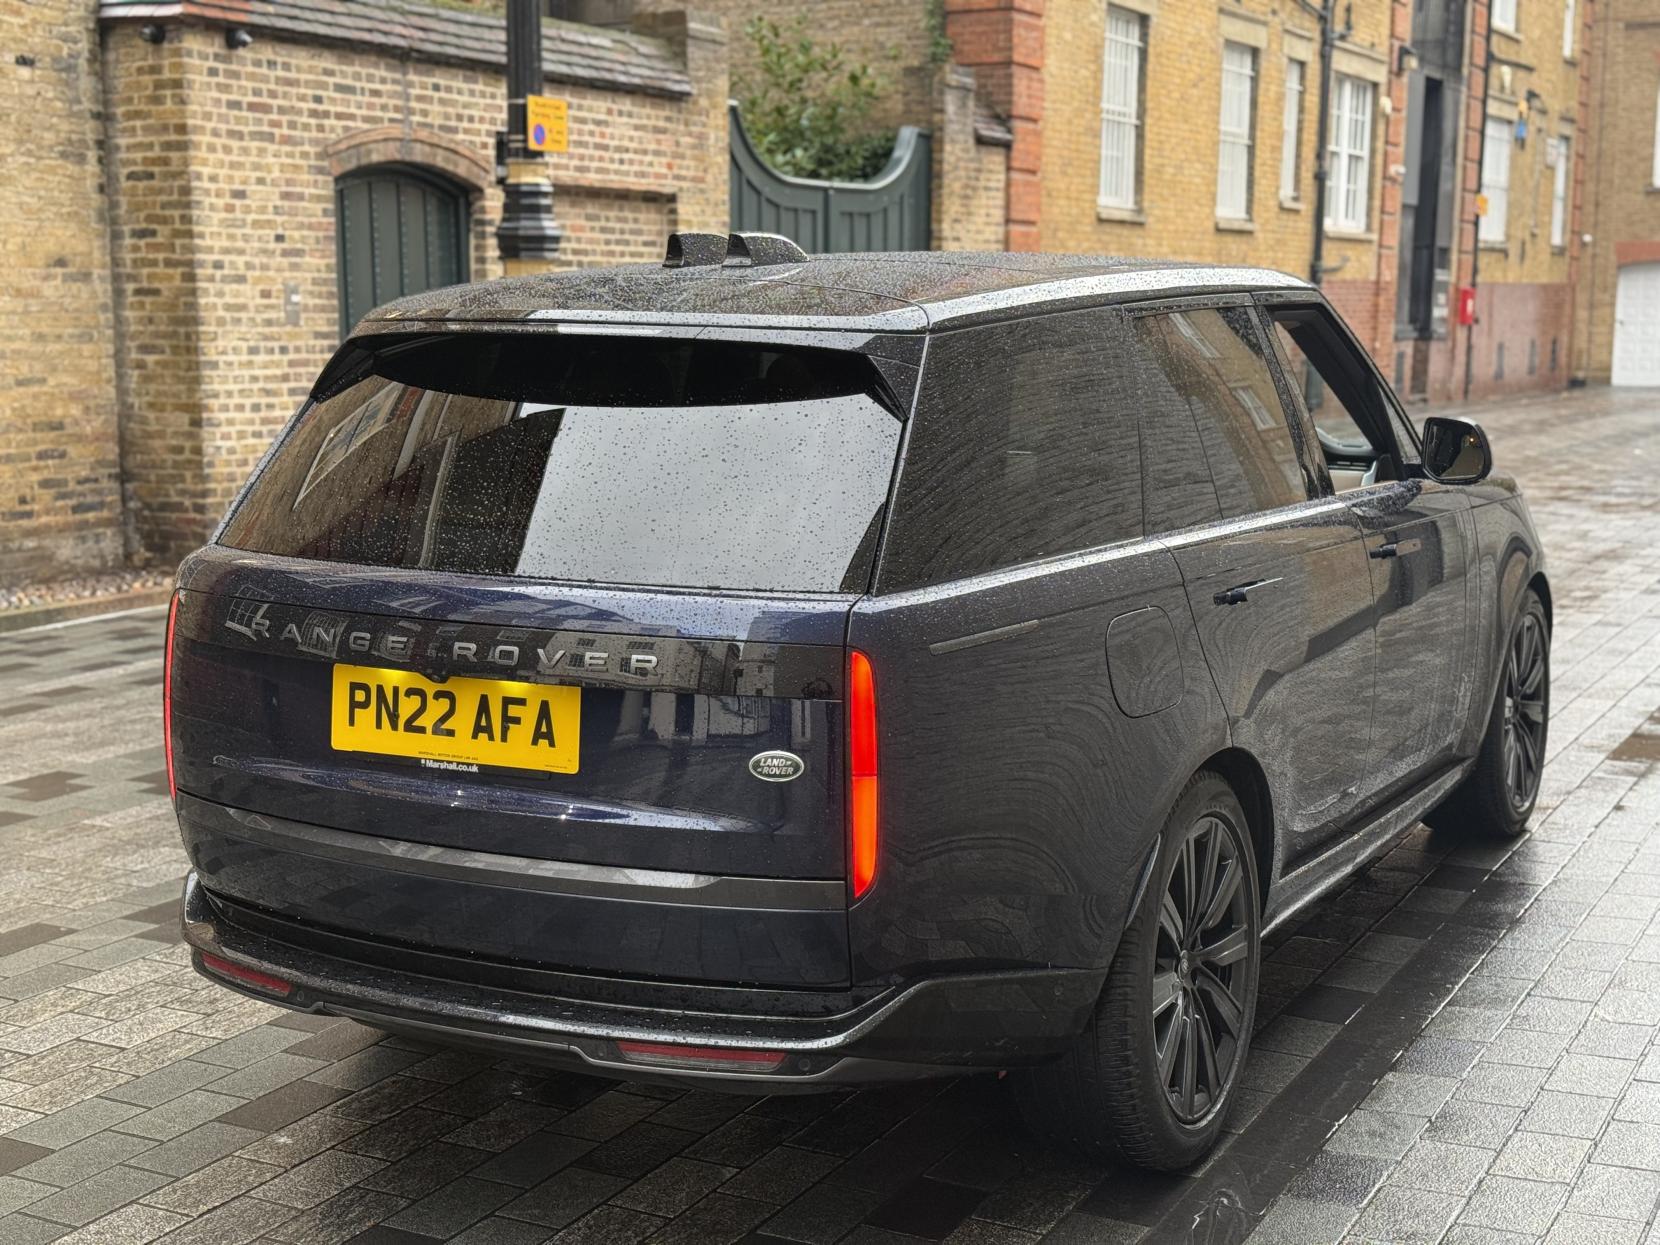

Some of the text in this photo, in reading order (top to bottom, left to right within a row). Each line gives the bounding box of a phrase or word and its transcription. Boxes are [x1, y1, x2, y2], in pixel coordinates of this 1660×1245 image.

[250, 617, 658, 676] RANGE ROVER
[348, 681, 556, 748] PN22 AFA
[426, 759, 479, 773] Marshall.co.uk
[760, 758, 785, 767] LAND
[762, 766, 794, 775] ROVER
